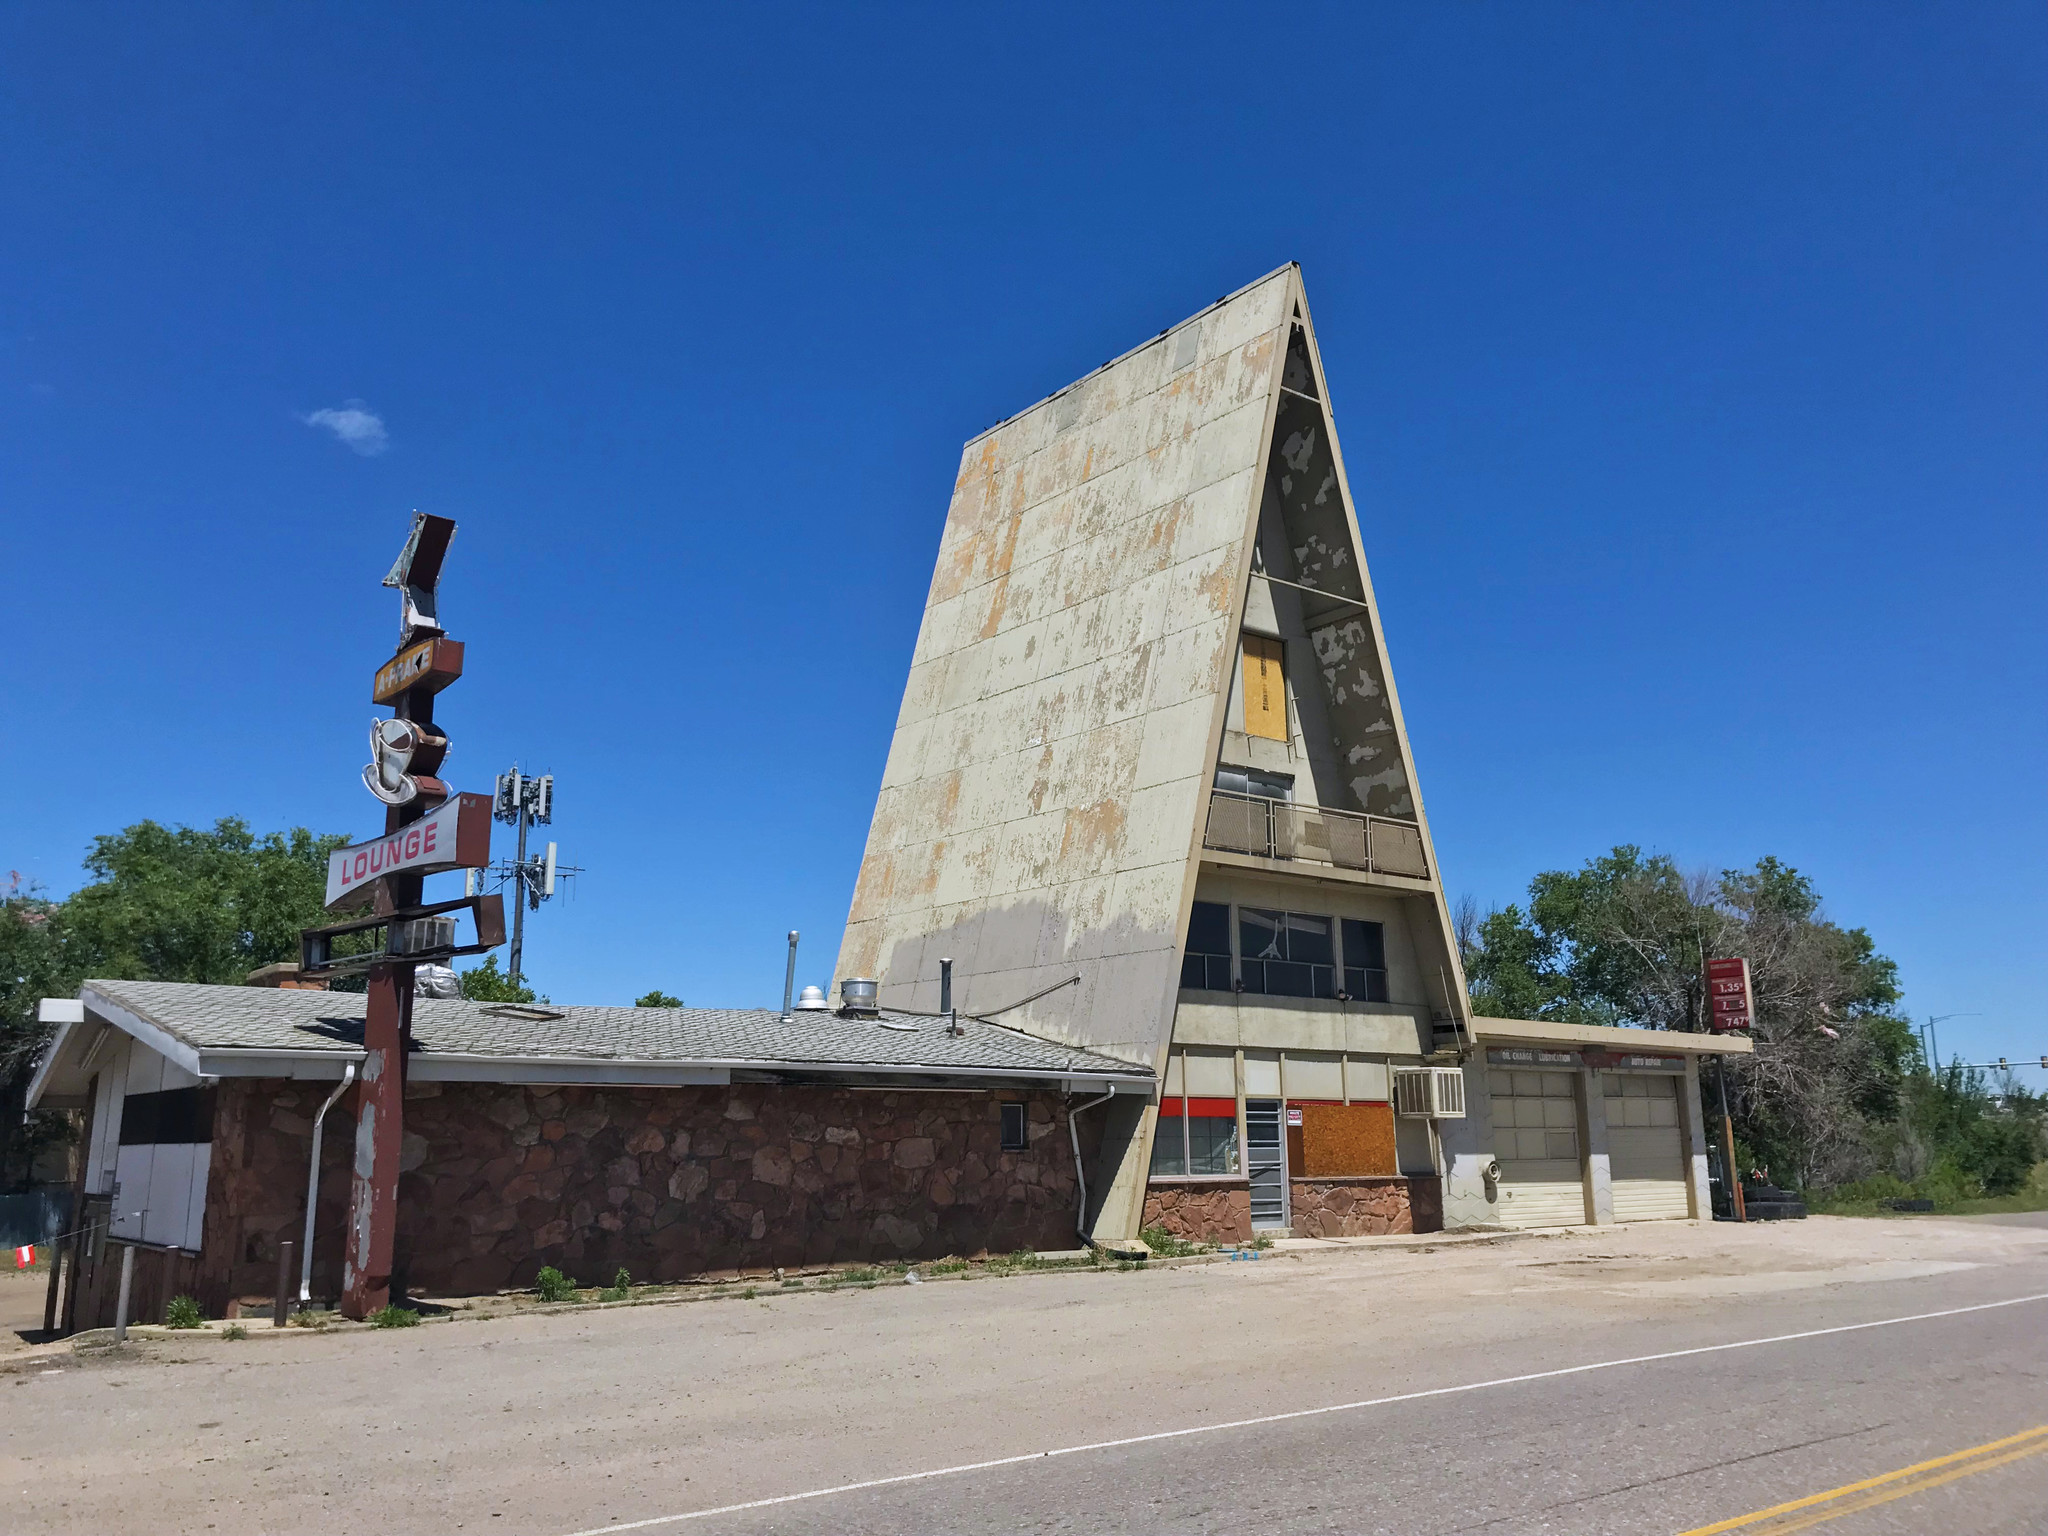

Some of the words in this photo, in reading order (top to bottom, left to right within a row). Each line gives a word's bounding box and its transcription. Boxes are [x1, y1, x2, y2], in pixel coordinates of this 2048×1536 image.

[341, 822, 438, 886] LOUNGE
[1502, 1051, 1511, 1060] OIL
[1512, 1052, 1533, 1062] CHANGE
[1538, 1053, 1571, 1063] LUBRICATION
[1631, 1057, 1645, 1066] AUTO
[1645, 1058, 1662, 1067] REPAIR
